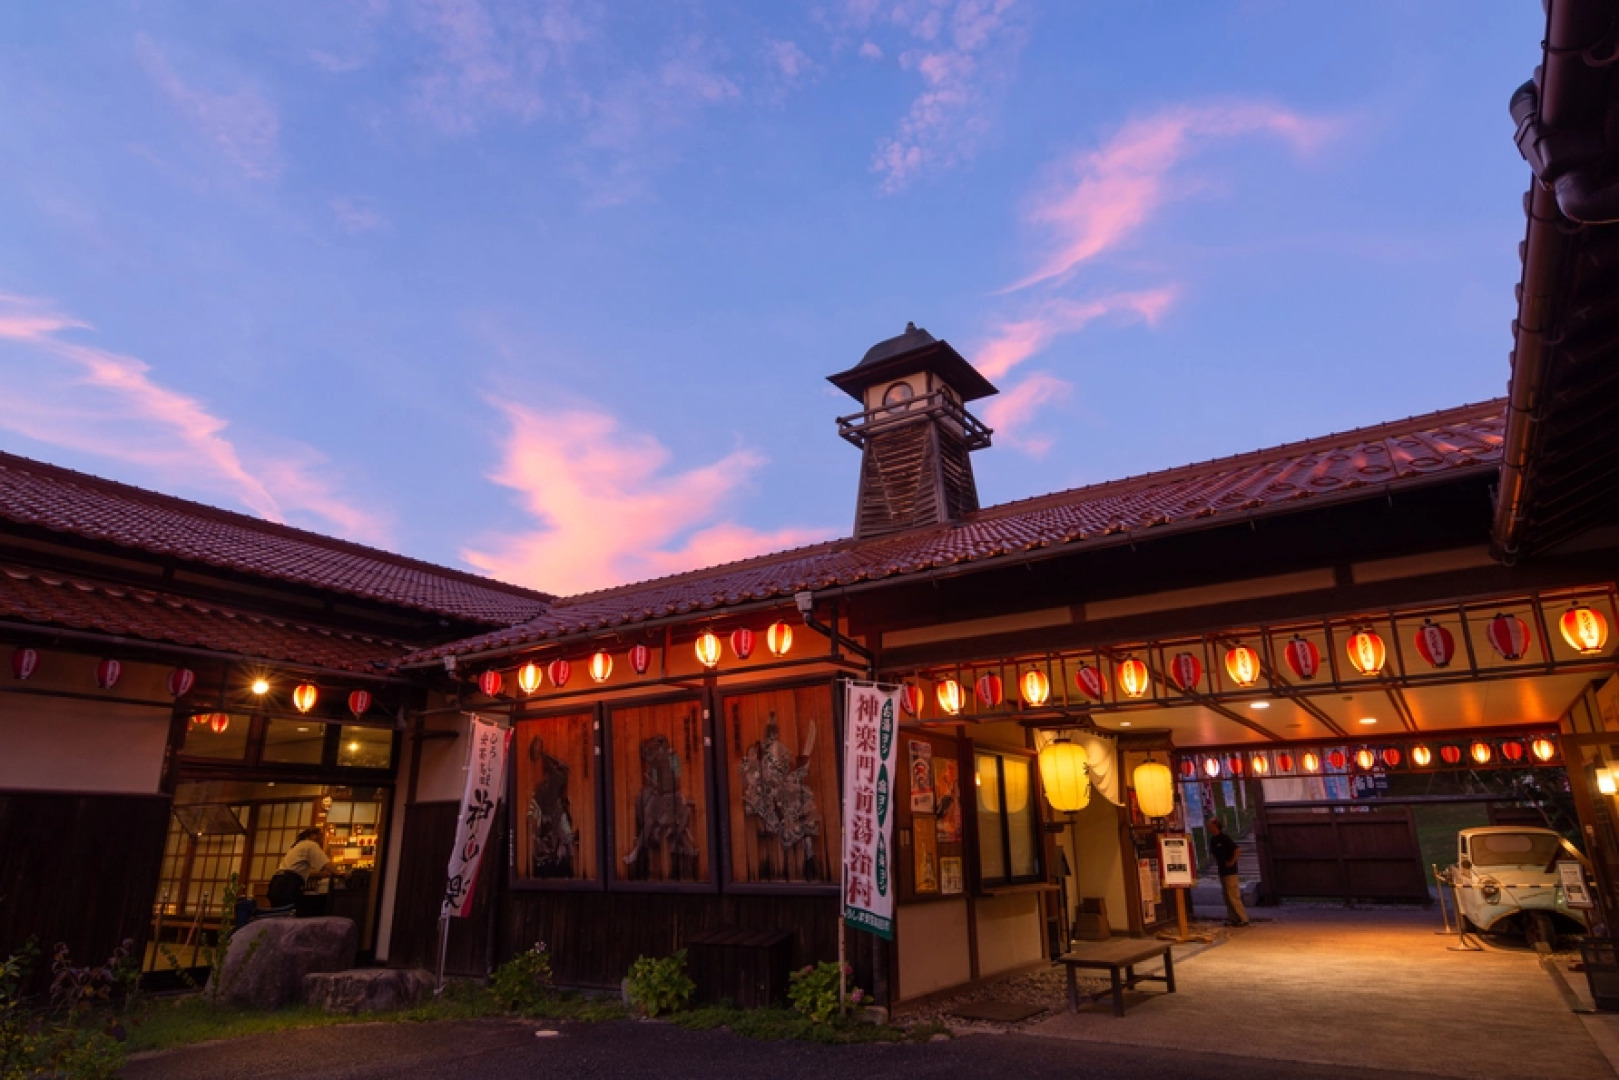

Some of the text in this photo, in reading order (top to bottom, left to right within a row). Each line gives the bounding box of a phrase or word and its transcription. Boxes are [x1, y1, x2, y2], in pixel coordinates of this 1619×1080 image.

[848, 694, 878, 907] 神楽門前湯治村
